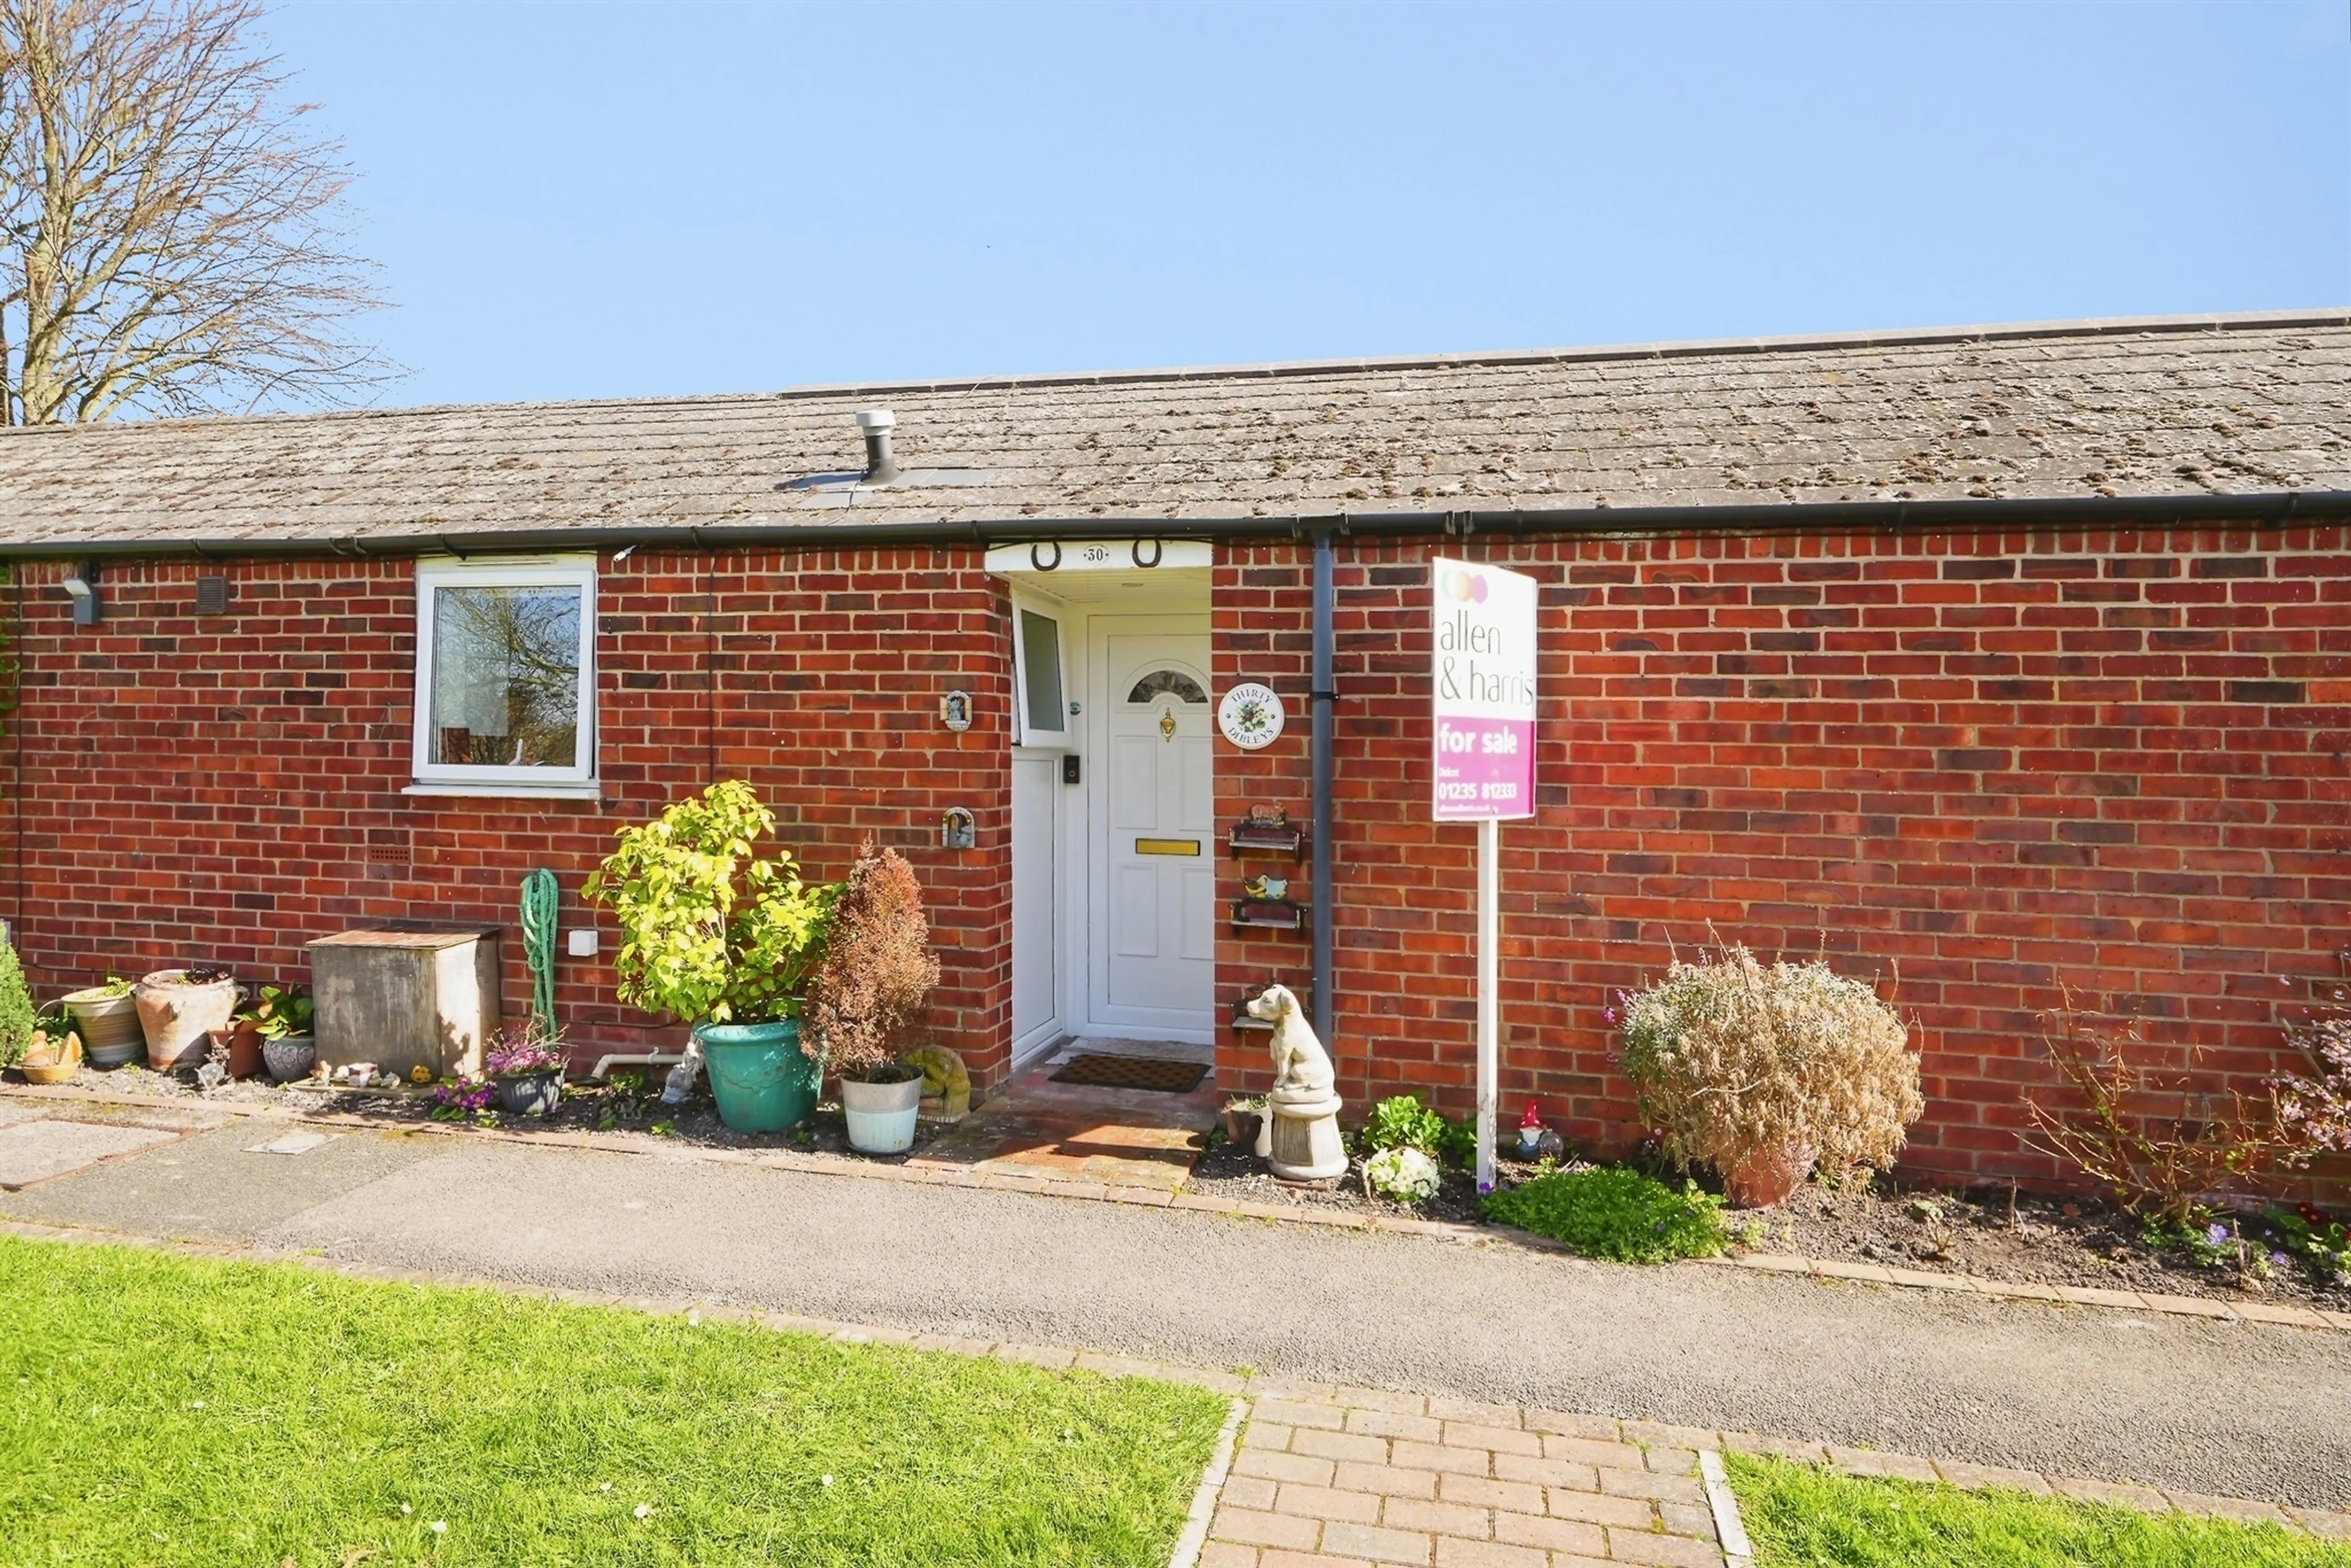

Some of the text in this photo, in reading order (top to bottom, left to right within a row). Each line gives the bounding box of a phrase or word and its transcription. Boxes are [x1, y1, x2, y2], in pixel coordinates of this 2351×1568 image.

[1087, 549, 1103, 561] 30
[1441, 609, 1501, 655] allen
[1441, 655, 1534, 705] & harris
[1231, 689, 1273, 703] THIRTY
[1228, 727, 1274, 744] DIBLEYS
[1439, 722, 1518, 754] for sale
[1438, 782, 1477, 800] 01235
